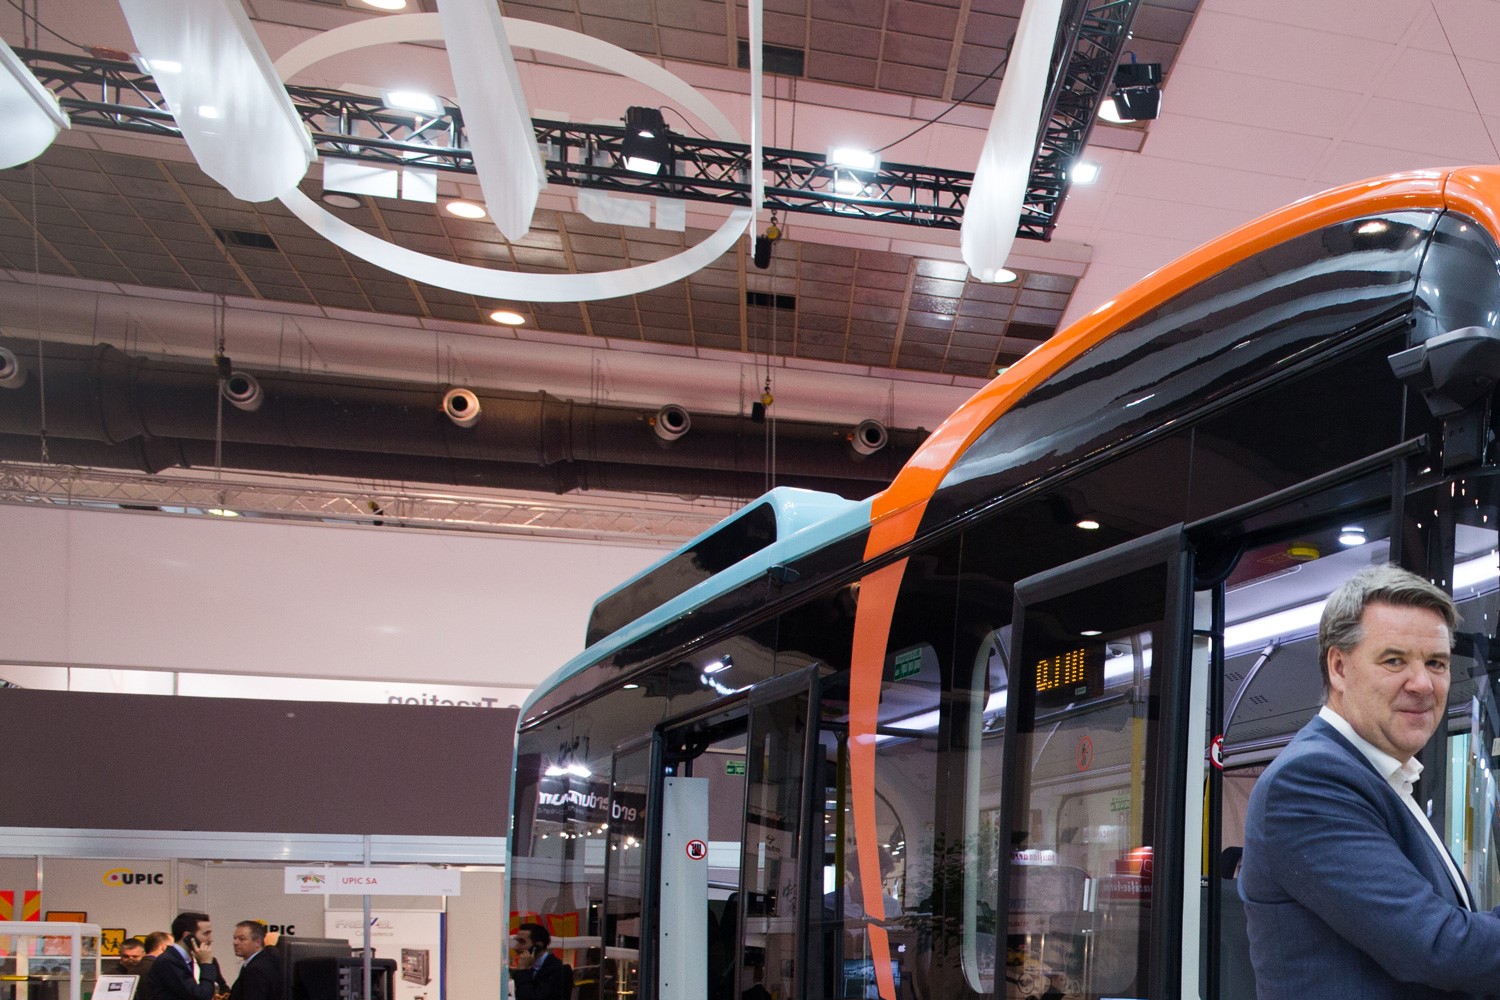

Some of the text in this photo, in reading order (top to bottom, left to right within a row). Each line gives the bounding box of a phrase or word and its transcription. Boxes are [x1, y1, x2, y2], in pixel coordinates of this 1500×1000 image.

[122, 873, 163, 885] UPIC
[342, 877, 378, 885] UPIC SA
